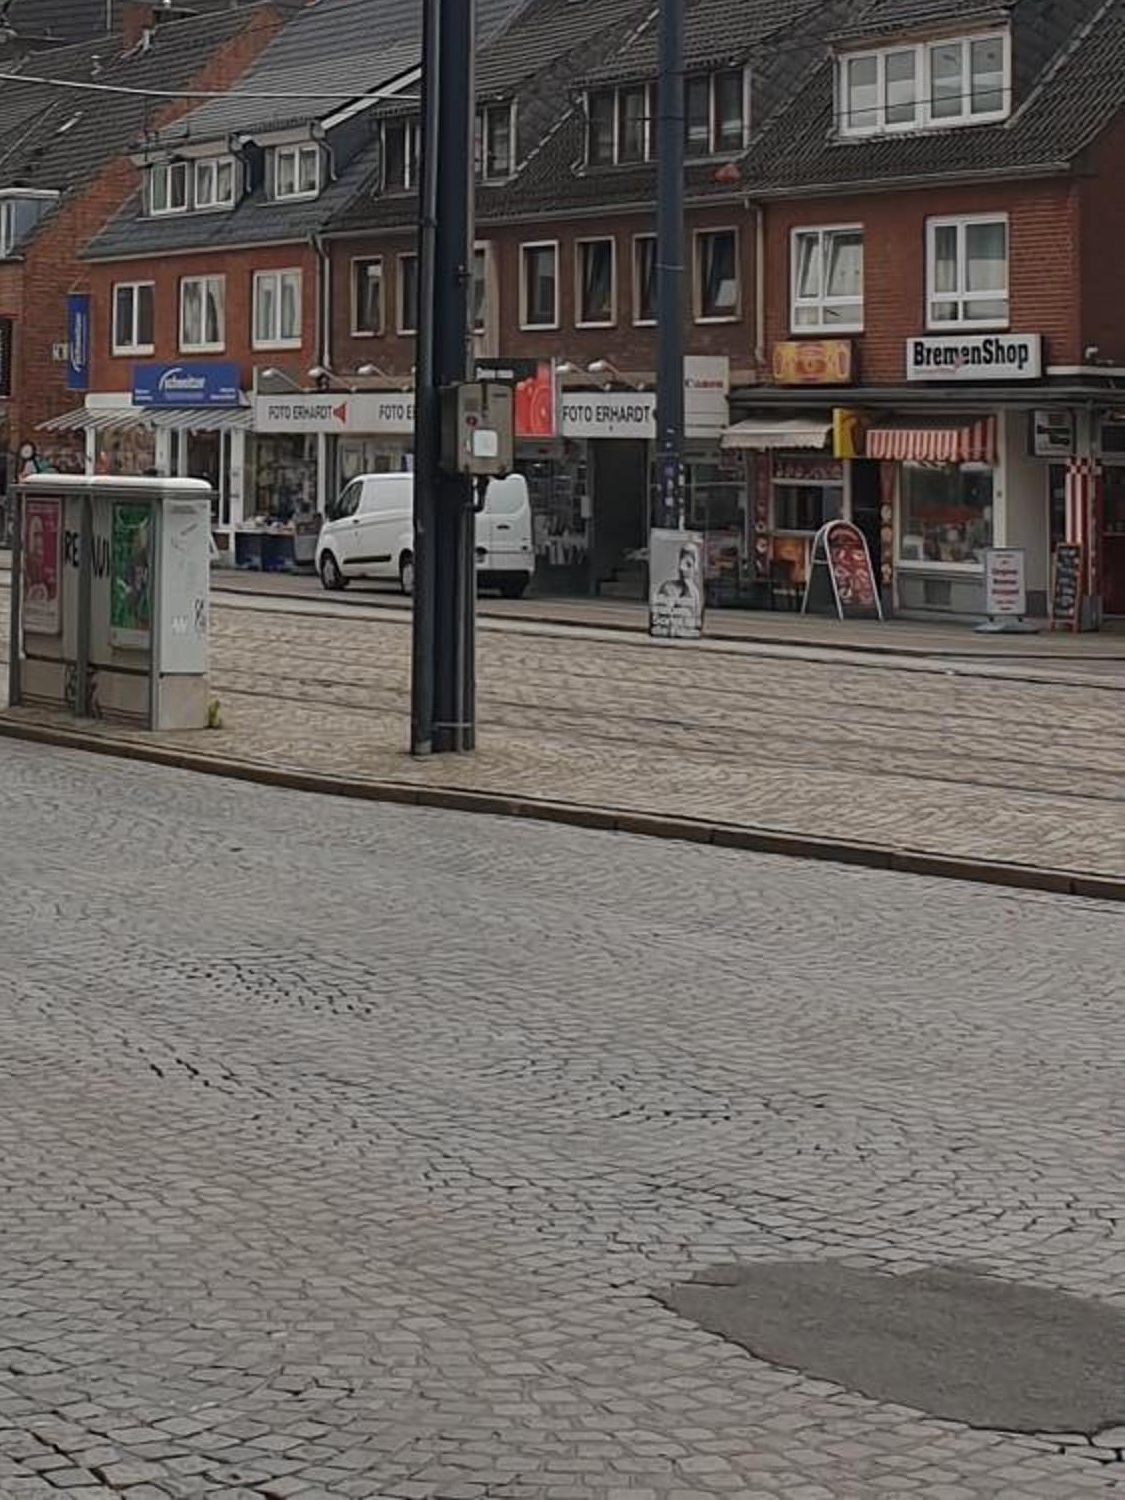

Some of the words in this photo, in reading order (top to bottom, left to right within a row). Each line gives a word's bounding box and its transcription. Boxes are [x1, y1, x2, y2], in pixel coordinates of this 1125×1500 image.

[913, 338, 1029, 370] BremenShop
[268, 405, 291, 420] FOTO
[379, 403, 405, 420] FOTO
[562, 405, 592, 422] FOTO
[595, 404, 651, 422] ERHARDT
